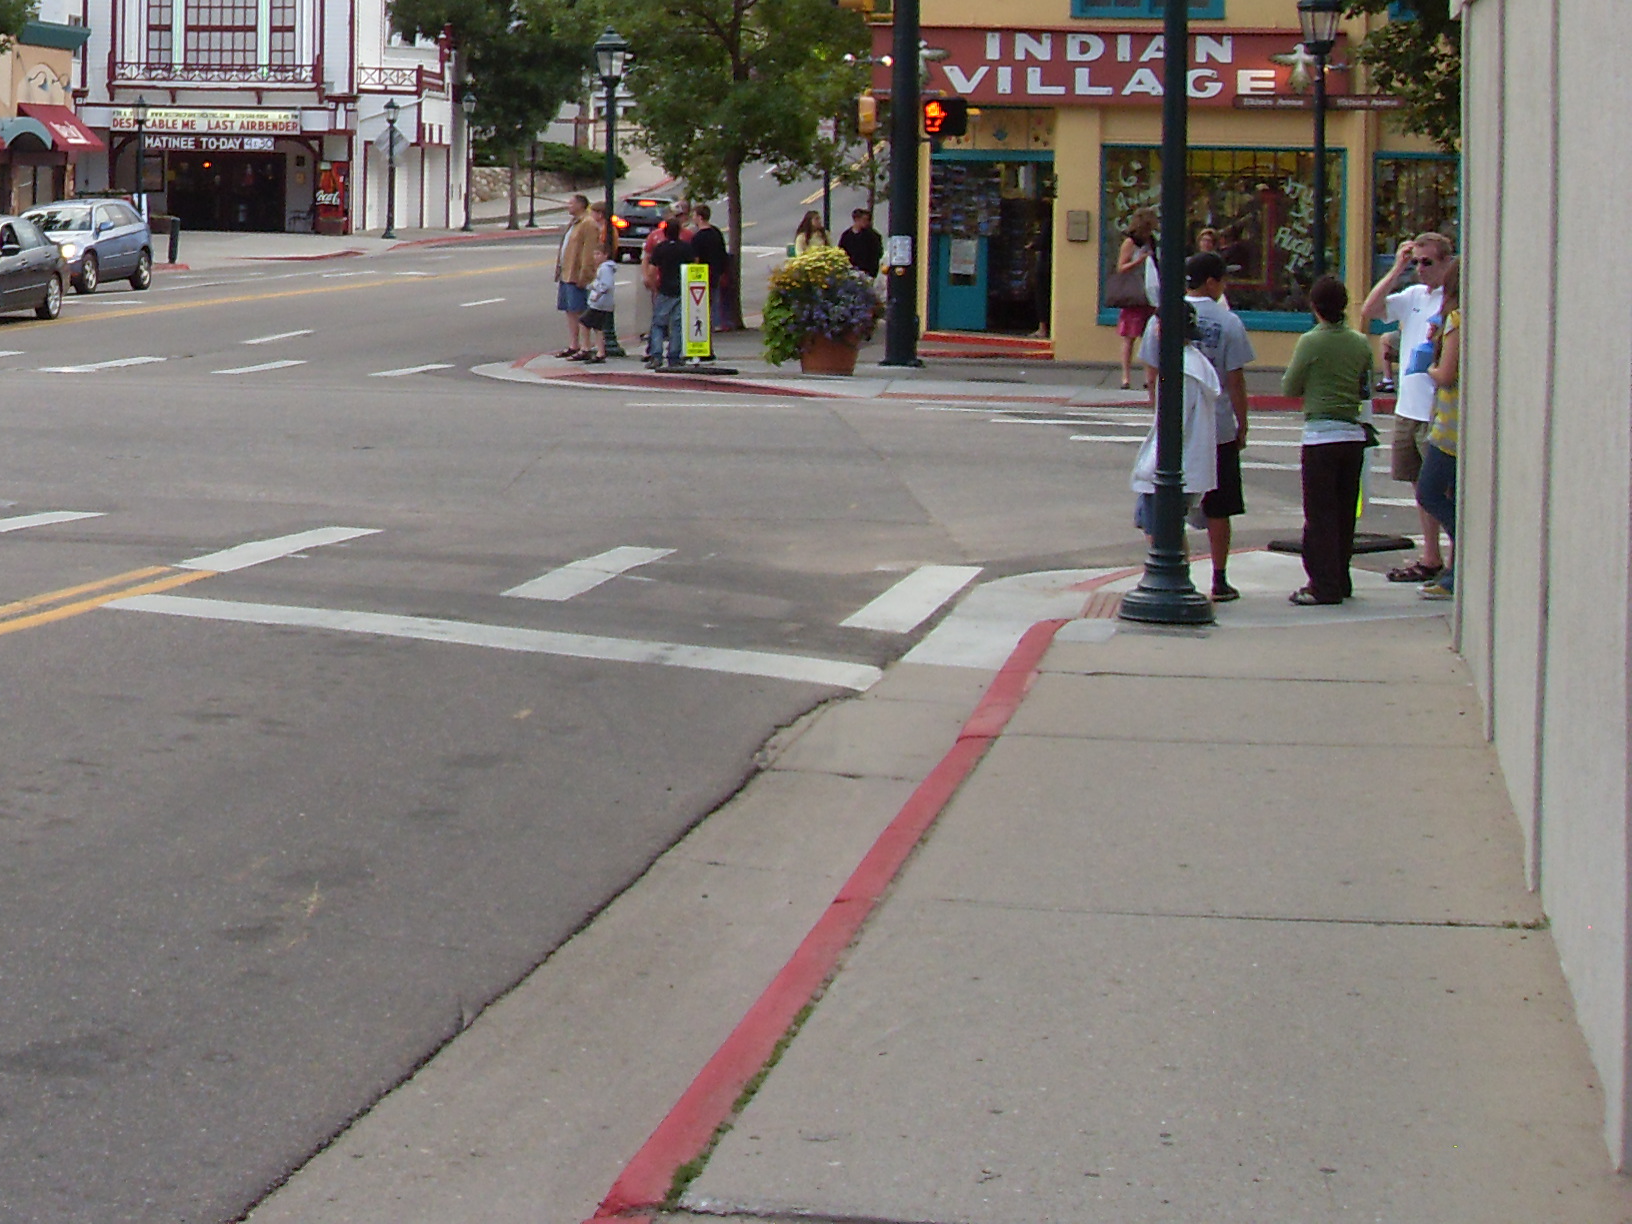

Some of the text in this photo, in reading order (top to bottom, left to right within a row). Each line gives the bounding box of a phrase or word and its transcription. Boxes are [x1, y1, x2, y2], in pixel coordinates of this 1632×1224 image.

[984, 32, 1233, 64] INDIAN
[942, 65, 1277, 99] VILLAGE
[112, 117, 299, 132] DESPCABLE ME LAST AIRBENDER
[144, 136, 196, 149] MATINEE
[199, 137, 243, 150] TO-DAY
